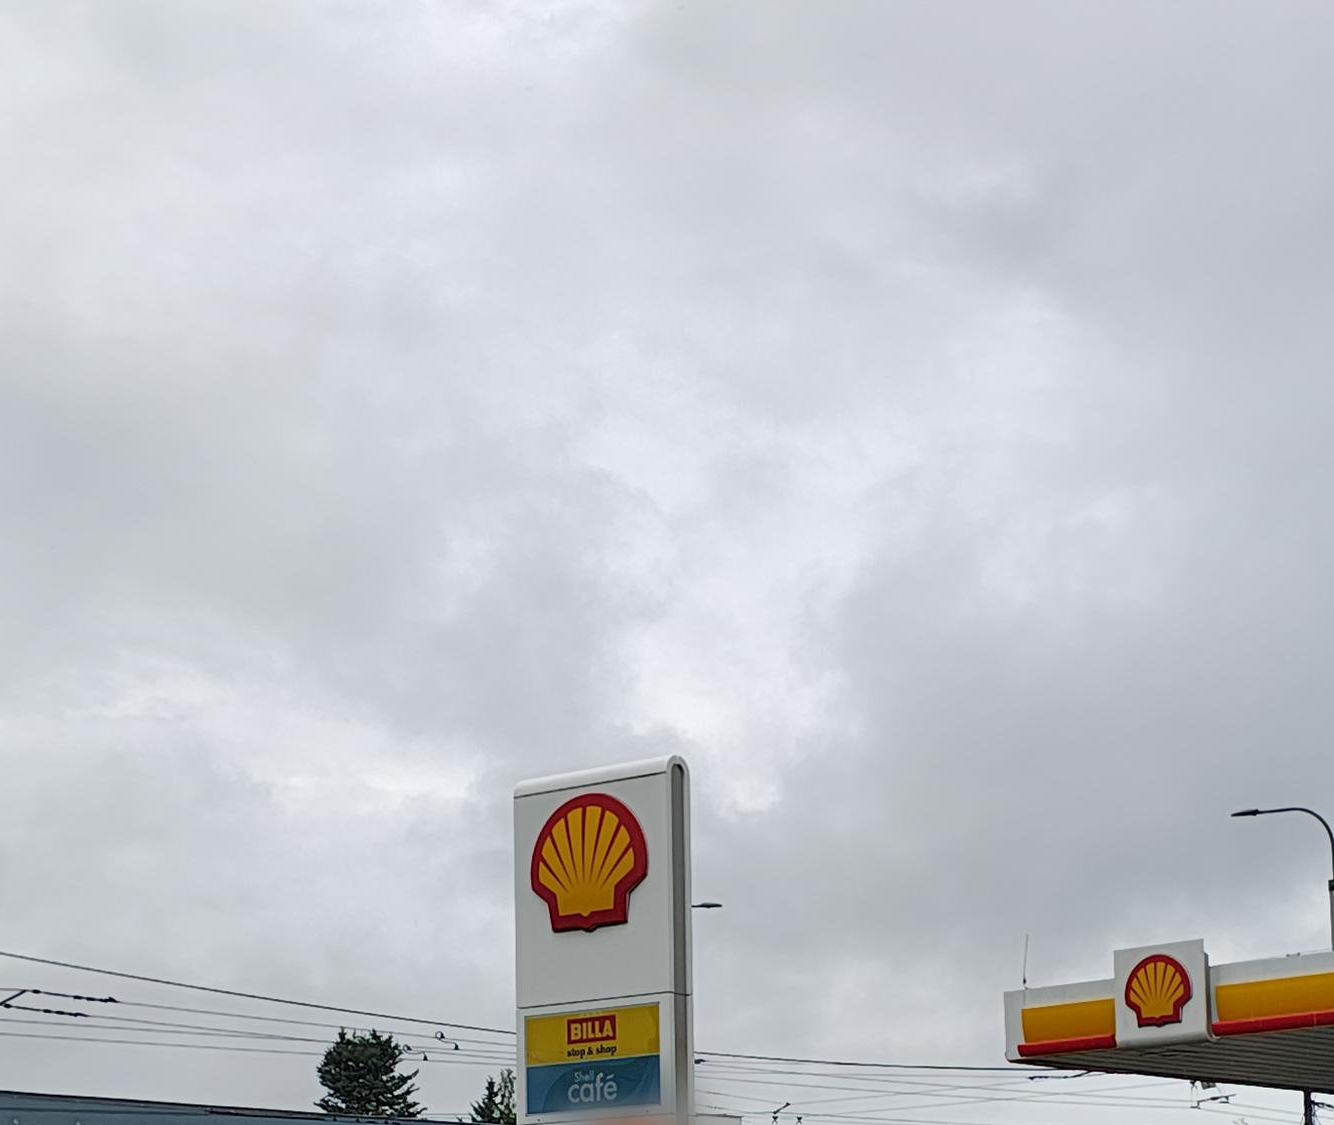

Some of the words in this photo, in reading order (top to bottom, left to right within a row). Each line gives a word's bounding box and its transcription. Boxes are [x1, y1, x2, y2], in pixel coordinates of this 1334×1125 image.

[570, 1019, 613, 1041] BILLA
[567, 1049, 585, 1059] stop
[587, 1048, 594, 1056] &
[596, 1045, 617, 1056] shop
[568, 1073, 618, 1104] café
